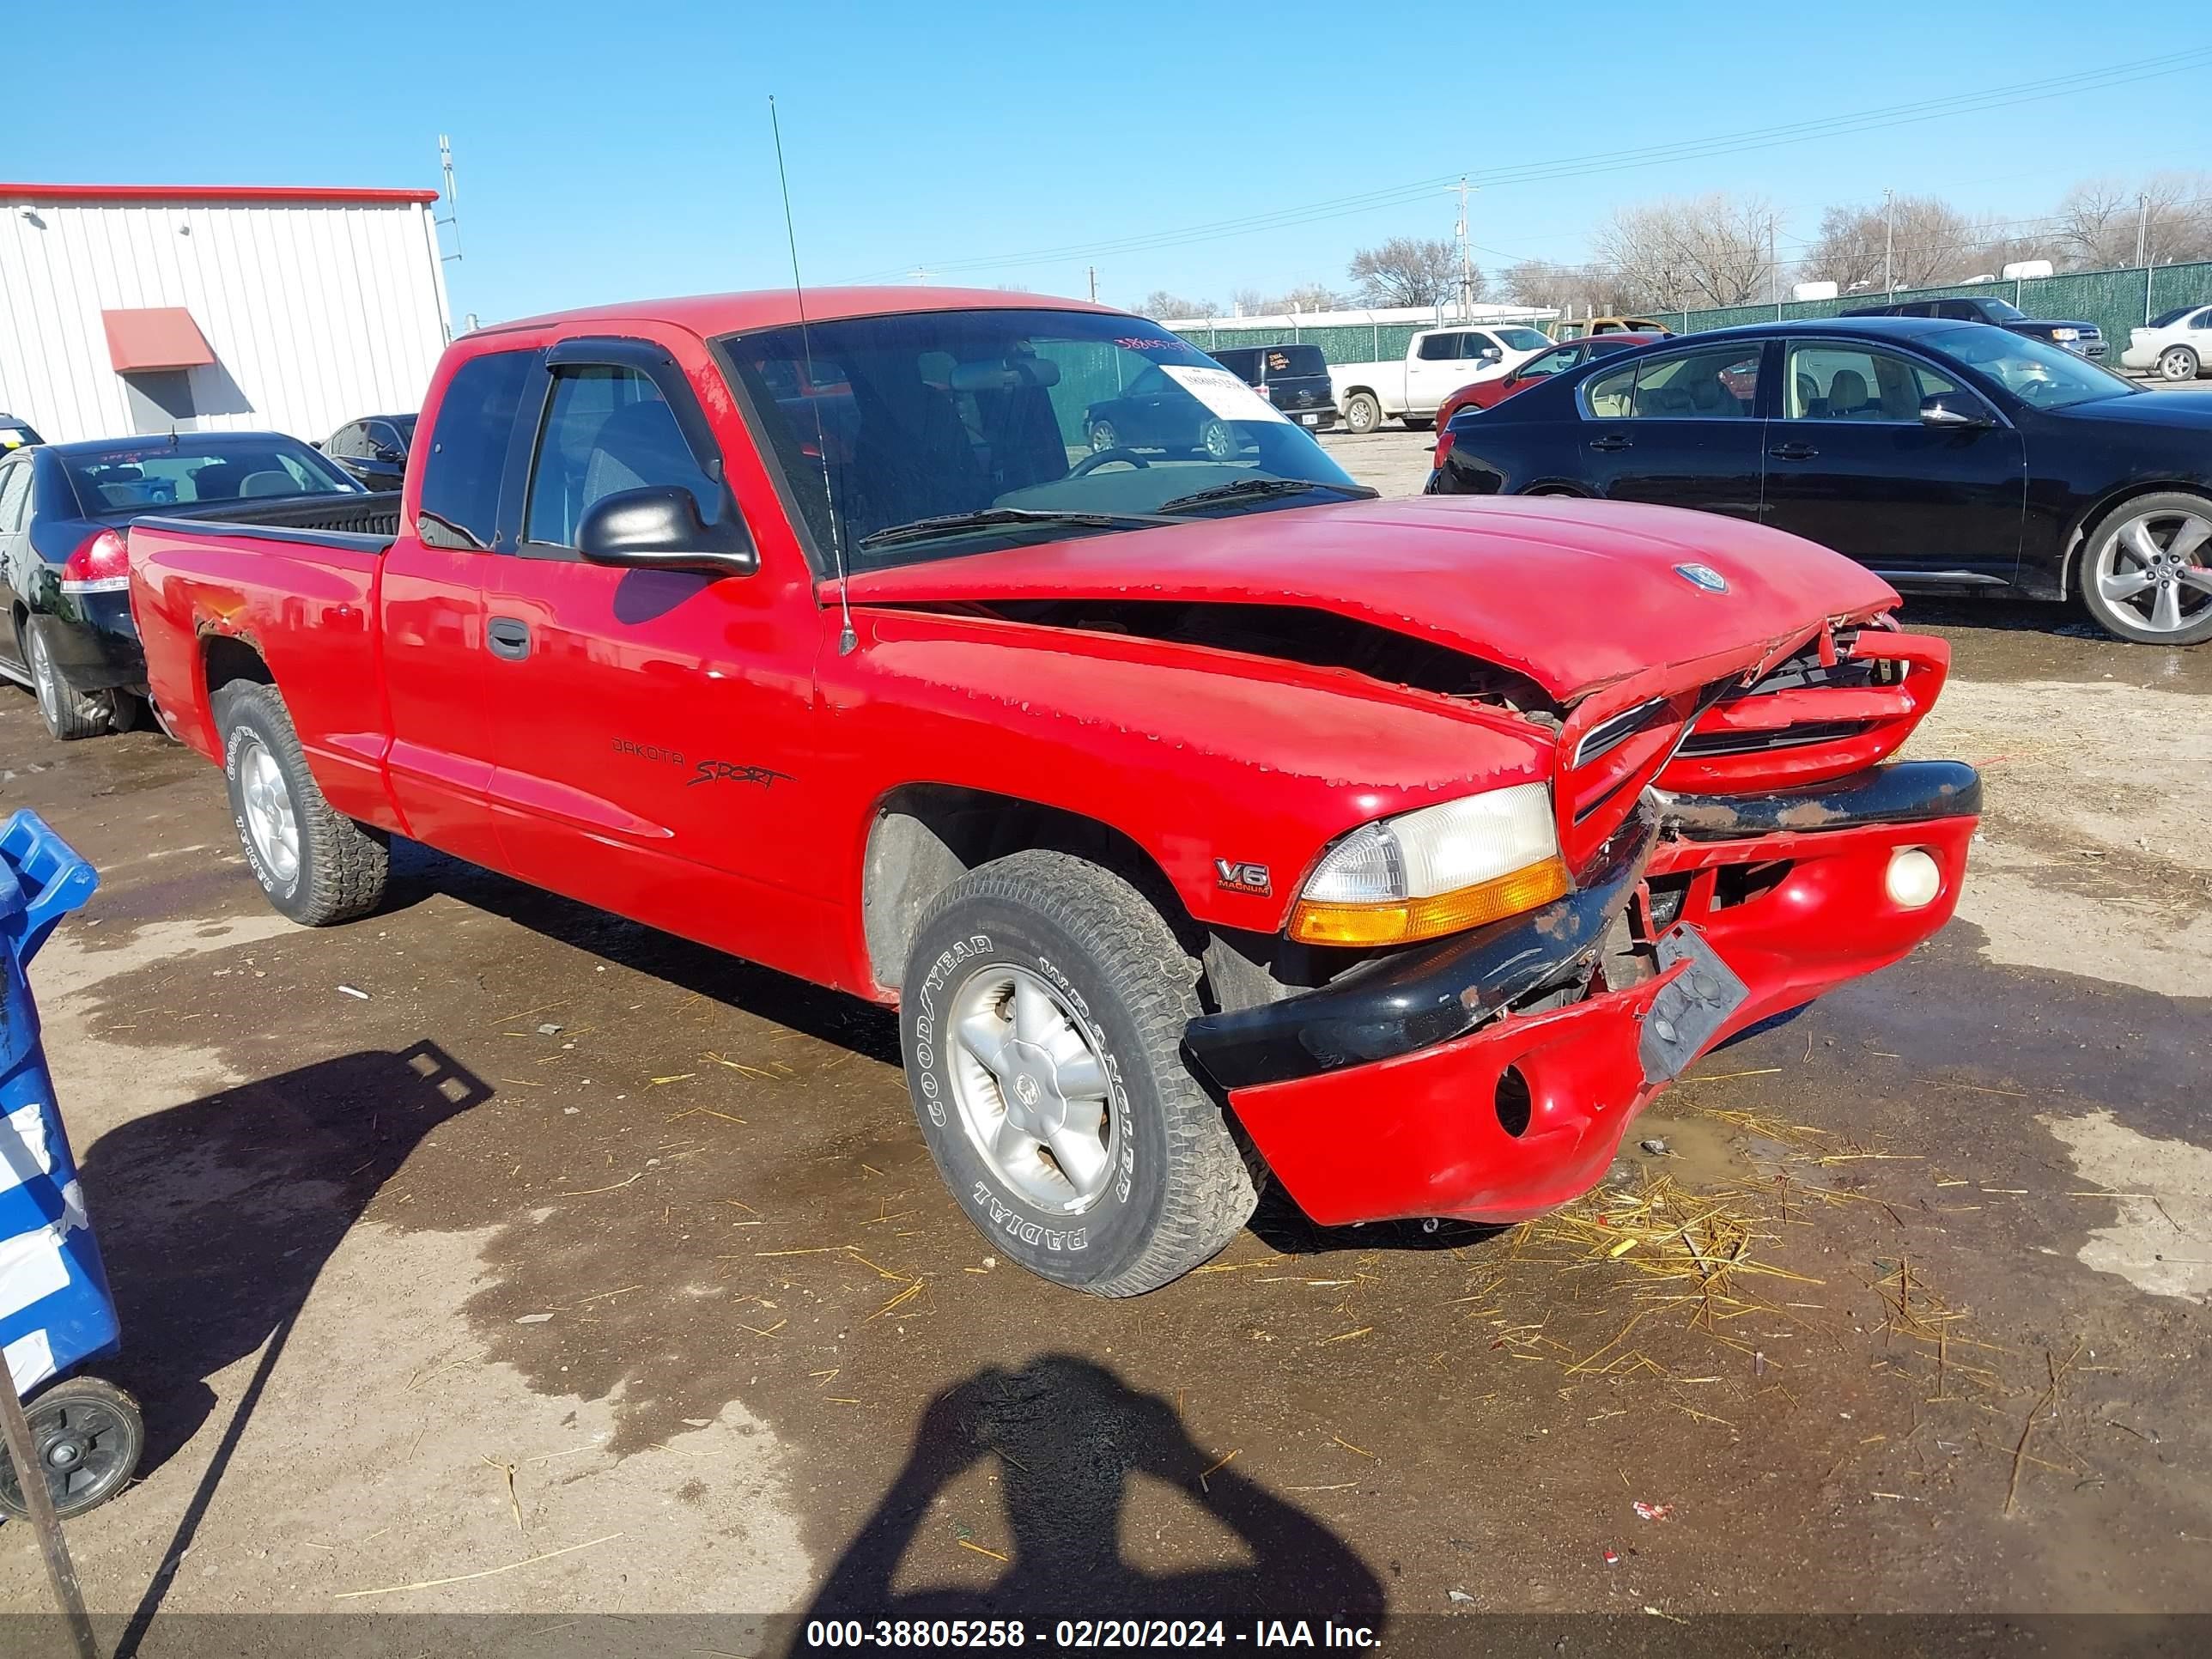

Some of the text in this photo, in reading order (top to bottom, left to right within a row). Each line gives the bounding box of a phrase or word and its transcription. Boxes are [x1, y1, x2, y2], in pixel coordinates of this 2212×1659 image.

[611, 737, 800, 791] DAKOTA SPORT
[235, 815, 274, 893] RADIAL
[1214, 858, 1268, 886] V6
[1217, 879, 1270, 895] MAGNUM
[1038, 956, 1135, 1204] WRANGLER
[973, 1180, 1089, 1251] RADIAL
